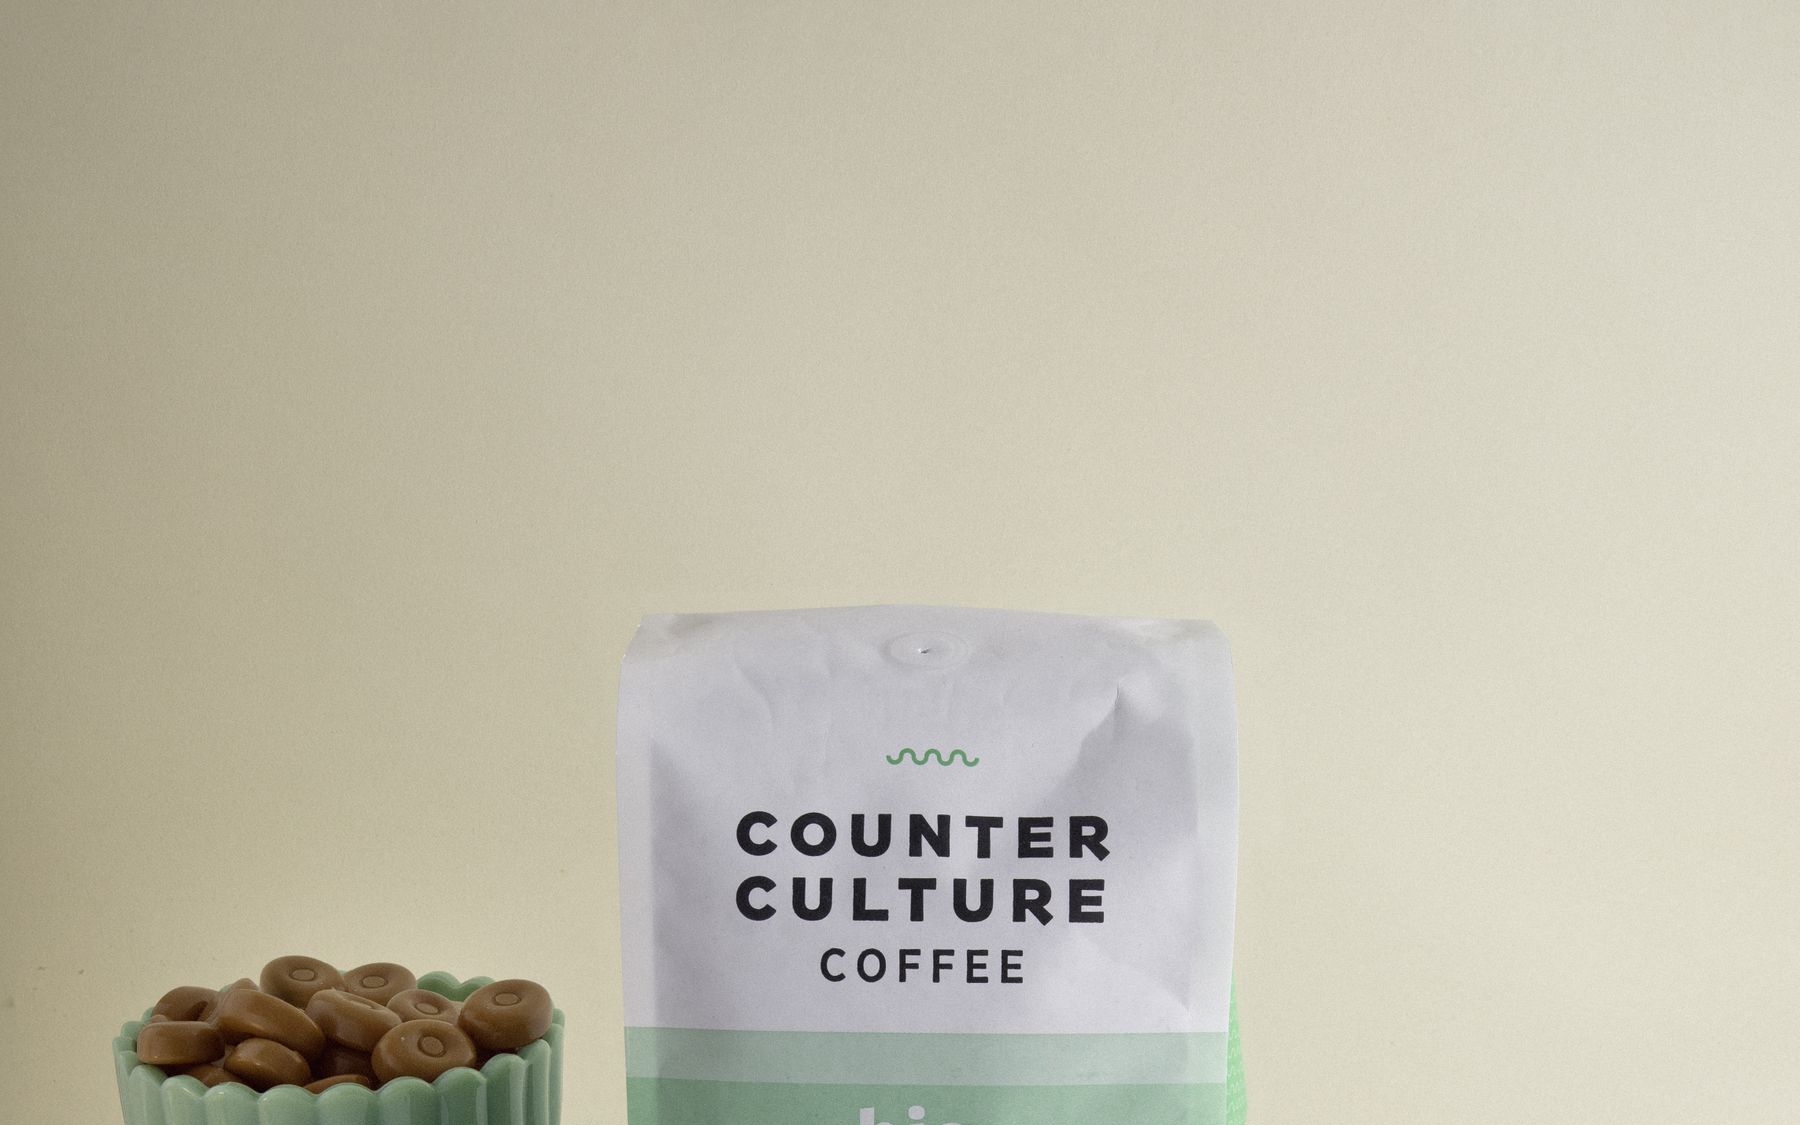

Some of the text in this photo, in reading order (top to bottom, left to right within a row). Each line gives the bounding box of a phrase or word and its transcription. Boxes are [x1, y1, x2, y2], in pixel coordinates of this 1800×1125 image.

[735, 810, 1111, 862] COUNTER
[735, 875, 1105, 927] CULTURE
[820, 947, 1024, 984] COFFEE
